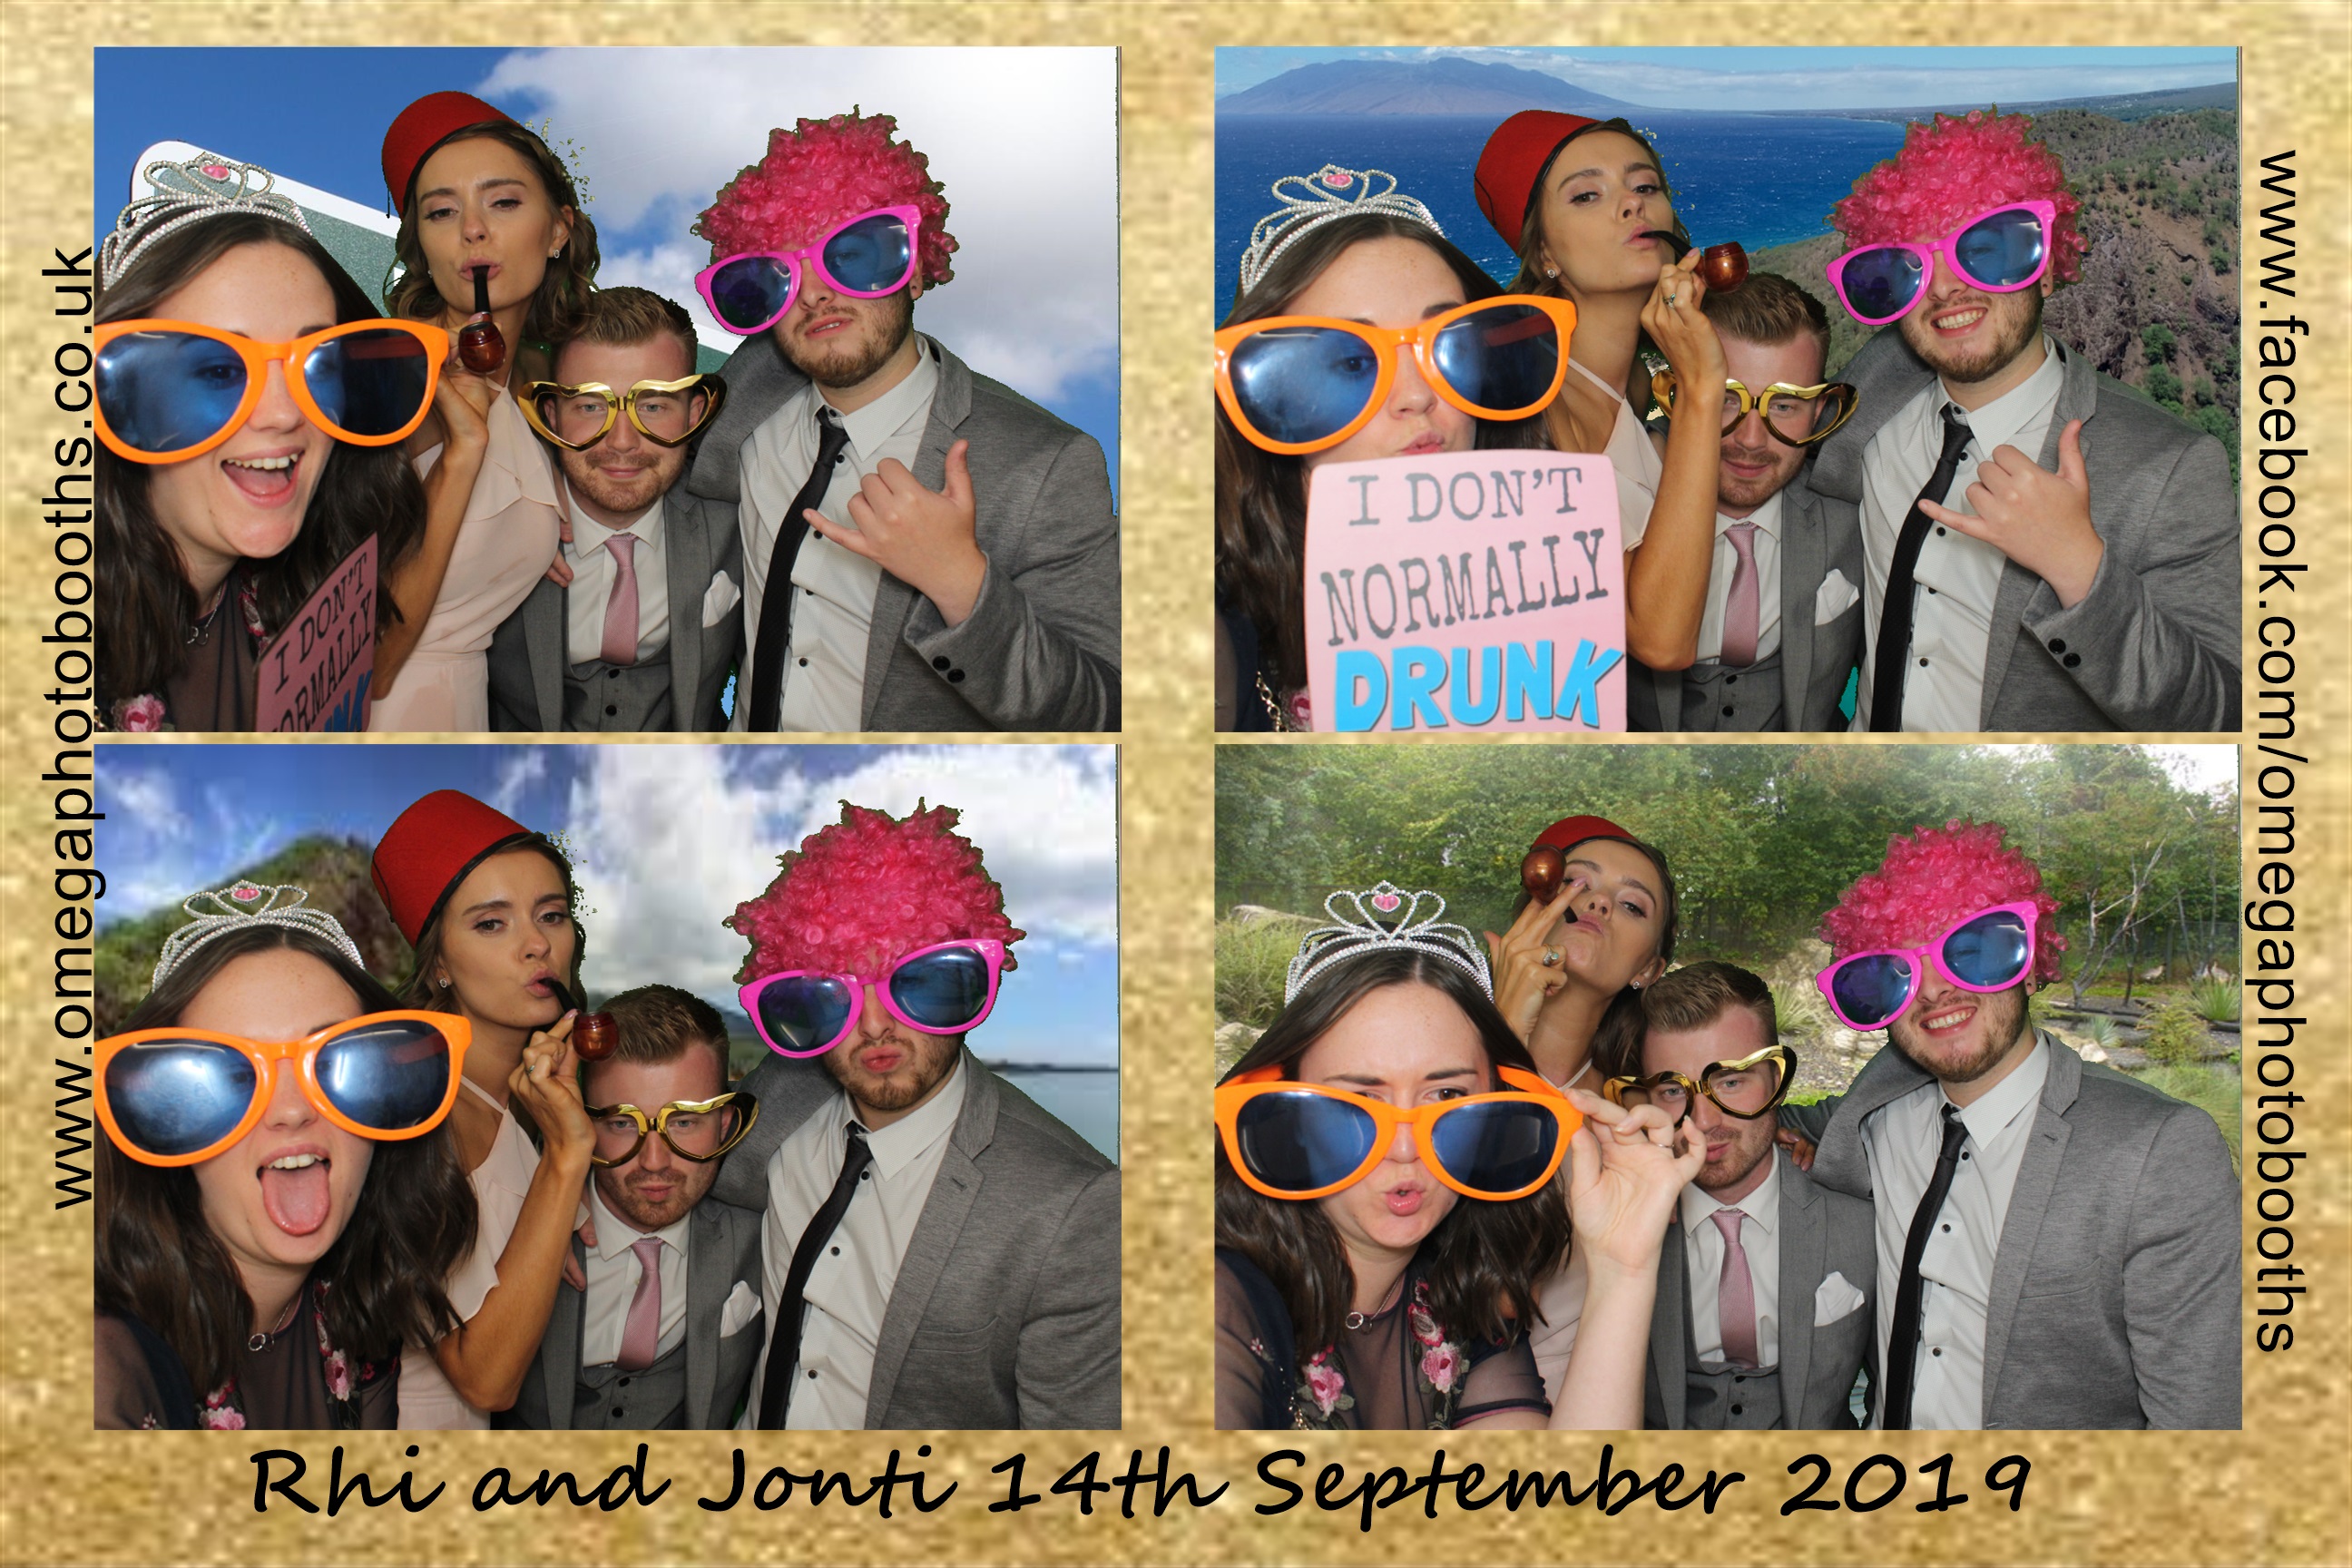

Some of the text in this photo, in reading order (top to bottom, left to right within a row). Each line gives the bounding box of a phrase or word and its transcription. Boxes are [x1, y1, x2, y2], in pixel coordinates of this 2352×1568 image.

[1348, 467, 1583, 526] I DON'T
[275, 641, 289, 694] I
[299, 552, 368, 664] DON'T
[1320, 528, 1609, 646] NORMALLY
[271, 589, 372, 732] ORMALLY
[1335, 639, 1624, 732] DRUNK
